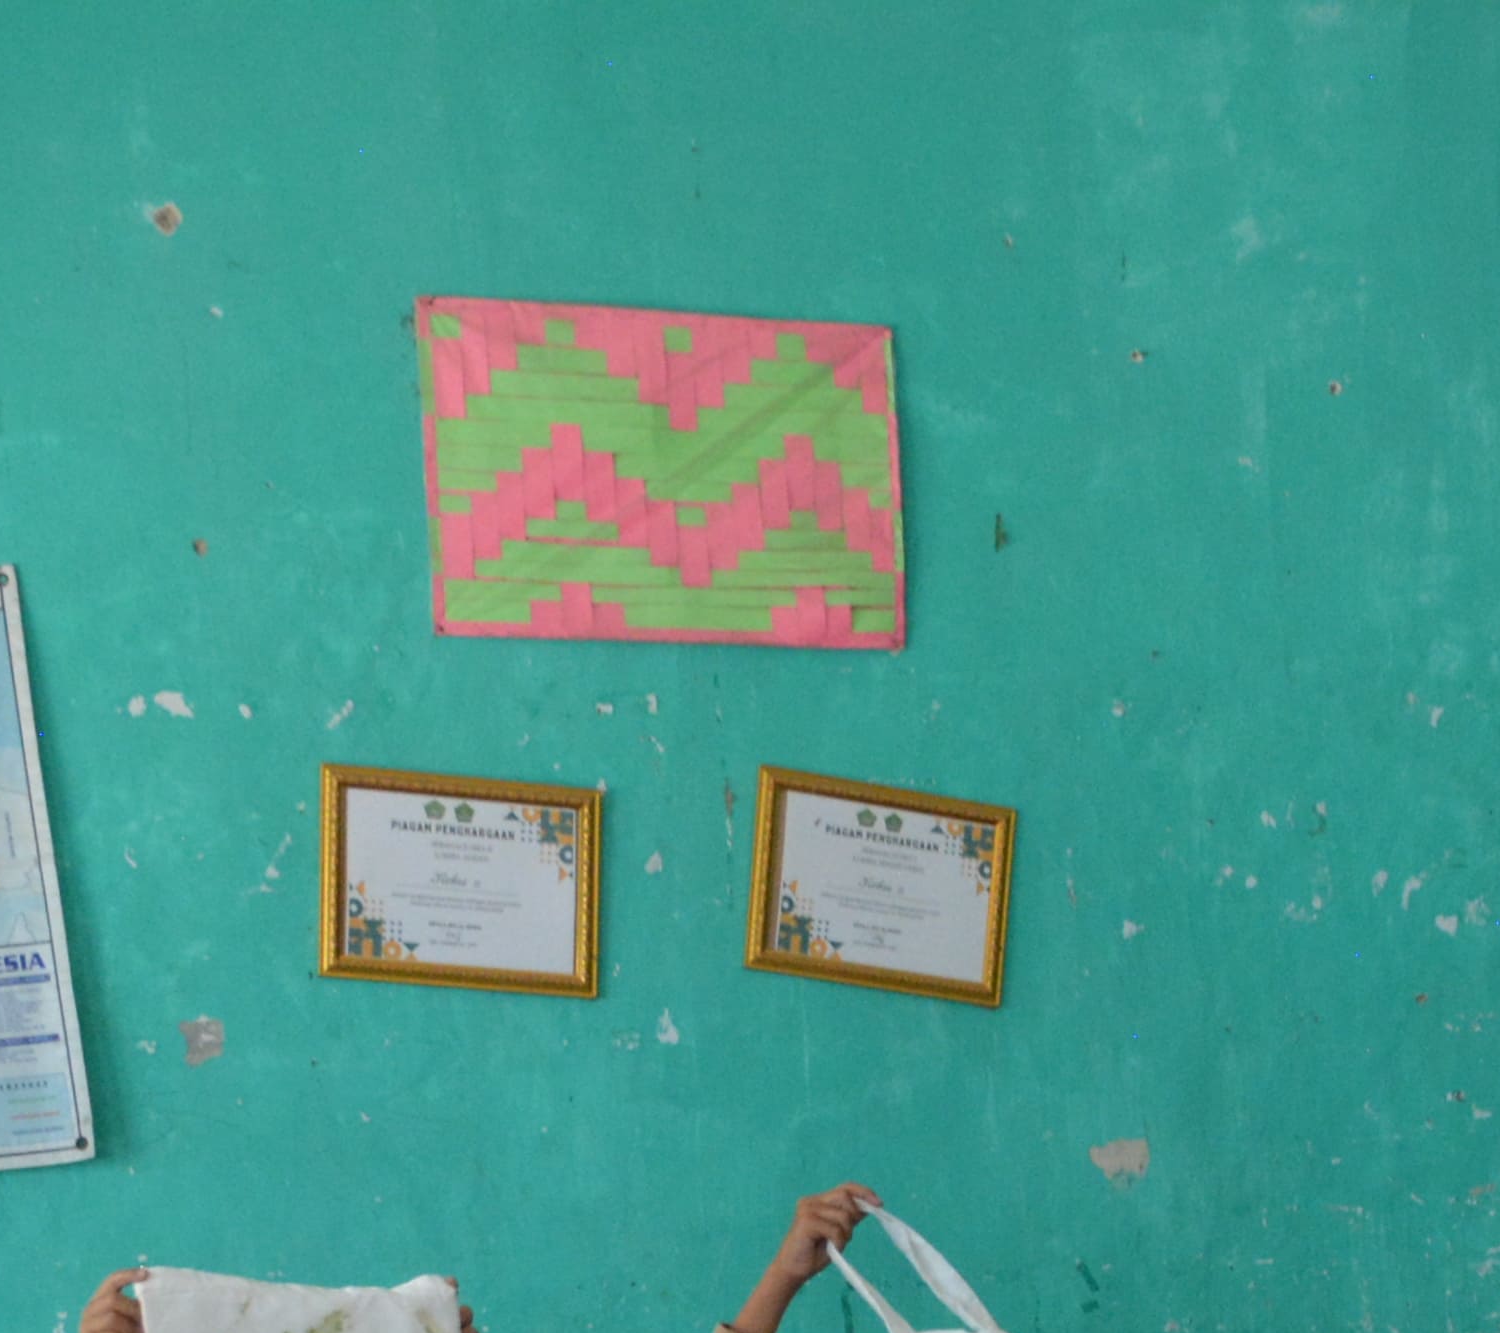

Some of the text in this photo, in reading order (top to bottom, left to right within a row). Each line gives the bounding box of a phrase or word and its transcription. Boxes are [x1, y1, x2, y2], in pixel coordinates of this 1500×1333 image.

[390, 819, 516, 841] PIAGAM PENGHARGAAN
[825, 824, 940, 852] PIAGAM PENGHARGAAN
